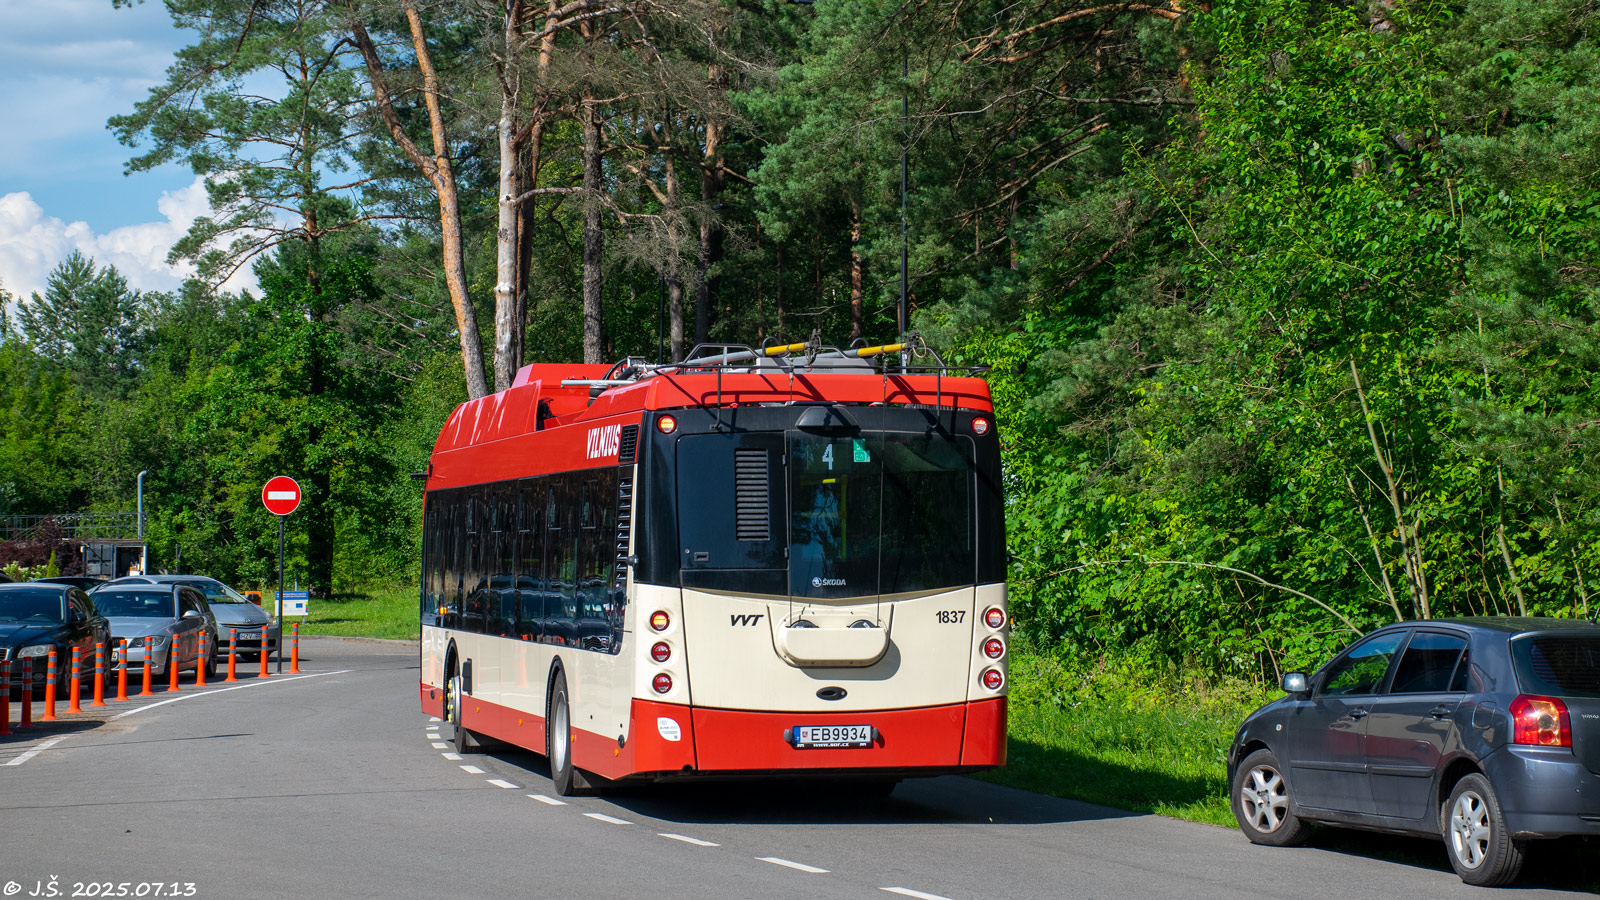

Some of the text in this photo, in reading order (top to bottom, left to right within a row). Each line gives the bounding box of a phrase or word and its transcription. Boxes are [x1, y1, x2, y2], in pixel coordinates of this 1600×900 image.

[586, 423, 621, 460] VILNIUS
[822, 443, 834, 470] 4
[822, 578, 847, 586] ŠKODA
[730, 614, 765, 627] VVT
[935, 610, 966, 624] 1837
[811, 727, 867, 742] EB9934
